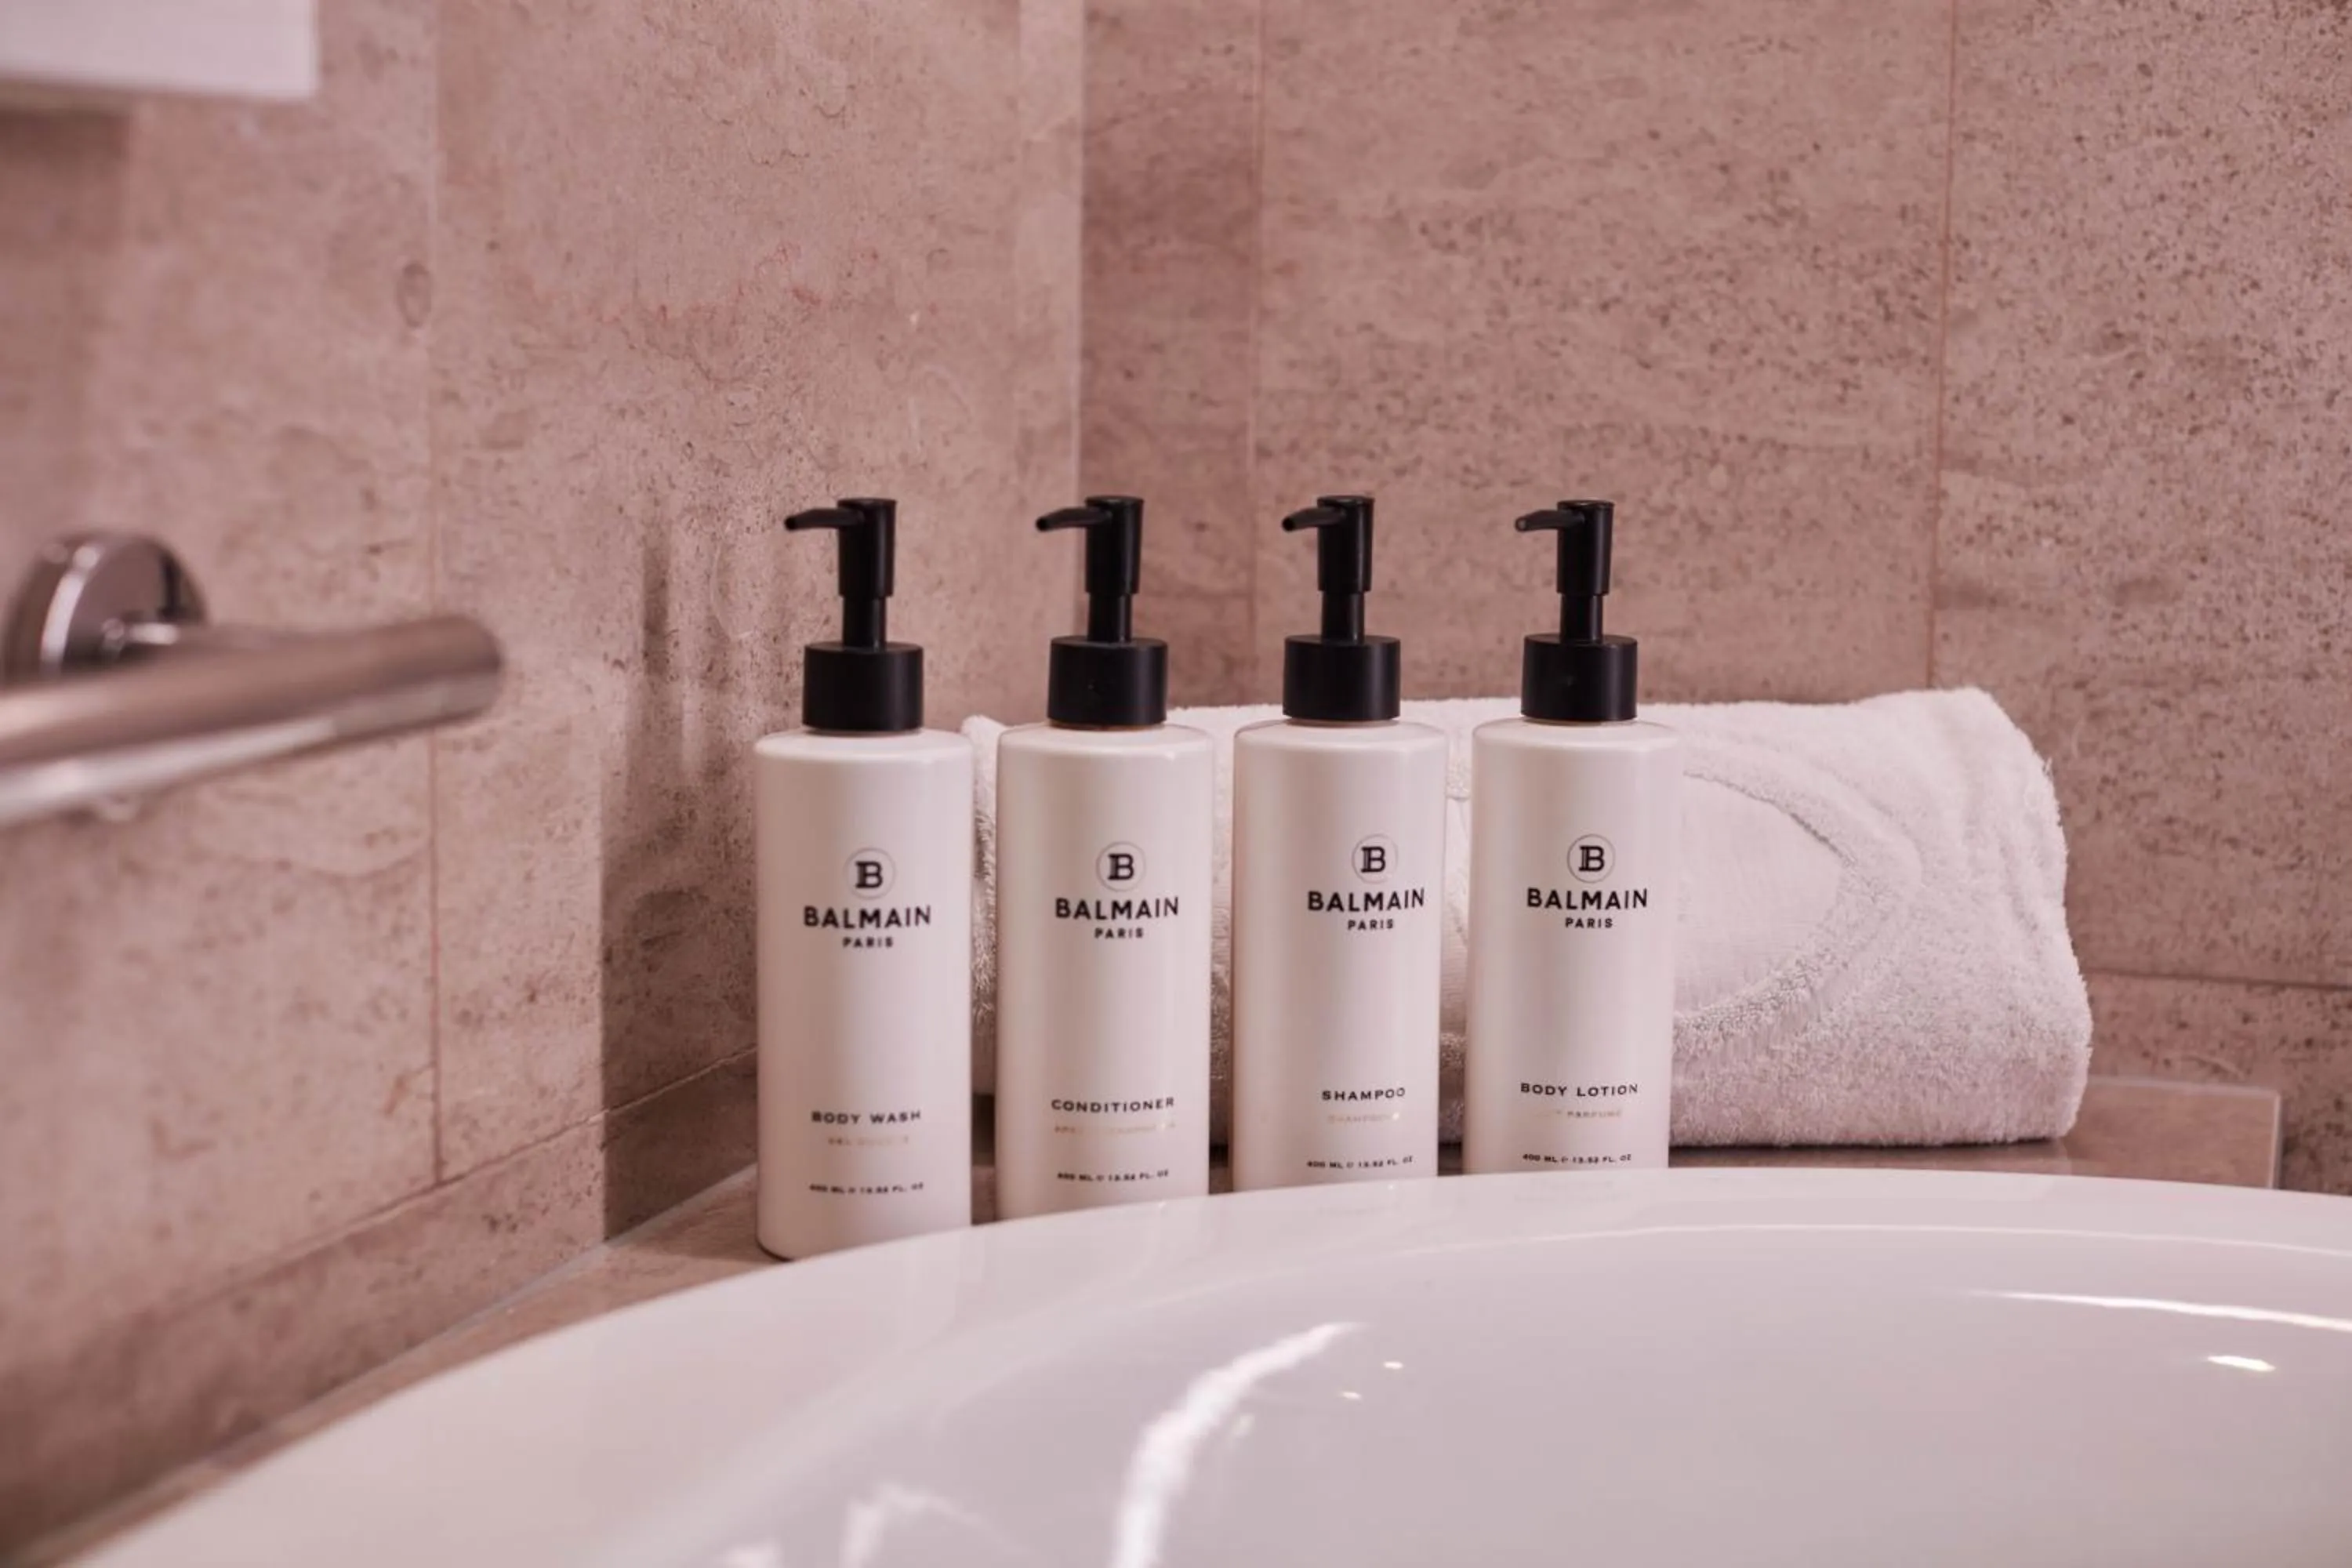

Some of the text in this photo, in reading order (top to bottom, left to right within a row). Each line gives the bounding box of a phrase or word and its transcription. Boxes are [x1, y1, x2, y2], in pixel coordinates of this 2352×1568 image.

[1108, 853, 1134, 880] B
[1360, 846, 1386, 873] B
[1578, 845, 1605, 872] B
[855, 860, 883, 888] B
[1055, 896, 1178, 920] BALMAIN
[1307, 887, 1425, 913] BALMAIN
[1526, 887, 1647, 910] BALMAIN
[804, 905, 931, 928] BALMAIN
[1347, 919, 1394, 931] PARIS
[1565, 917, 1613, 928] PARIS
[1094, 927, 1144, 938] PARIS
[843, 937, 893, 948] PARIS
[1322, 1087, 1406, 1101] SHAMPOO
[1520, 1082, 1639, 1097] BODY LOTION
[1051, 1097, 1174, 1112] CONDITIONER
[811, 1110, 921, 1124] BODY WASH
